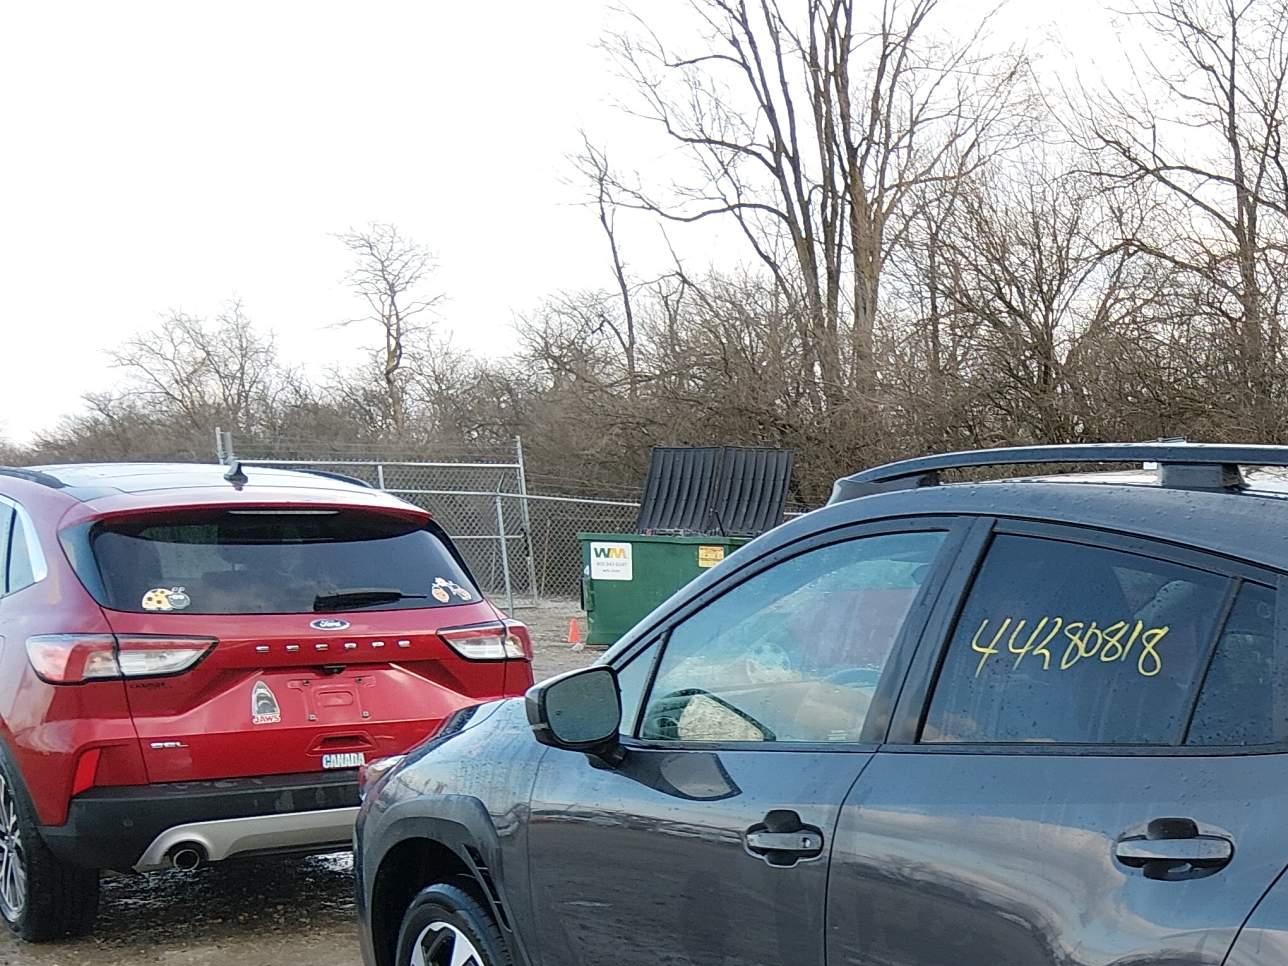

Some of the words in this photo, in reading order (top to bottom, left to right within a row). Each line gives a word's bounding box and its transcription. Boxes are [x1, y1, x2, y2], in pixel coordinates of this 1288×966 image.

[593, 547, 627, 559] WM
[971, 616, 1169, 678] 44280818
[254, 714, 280, 723] JAWS
[322, 752, 366, 769] CANADA
